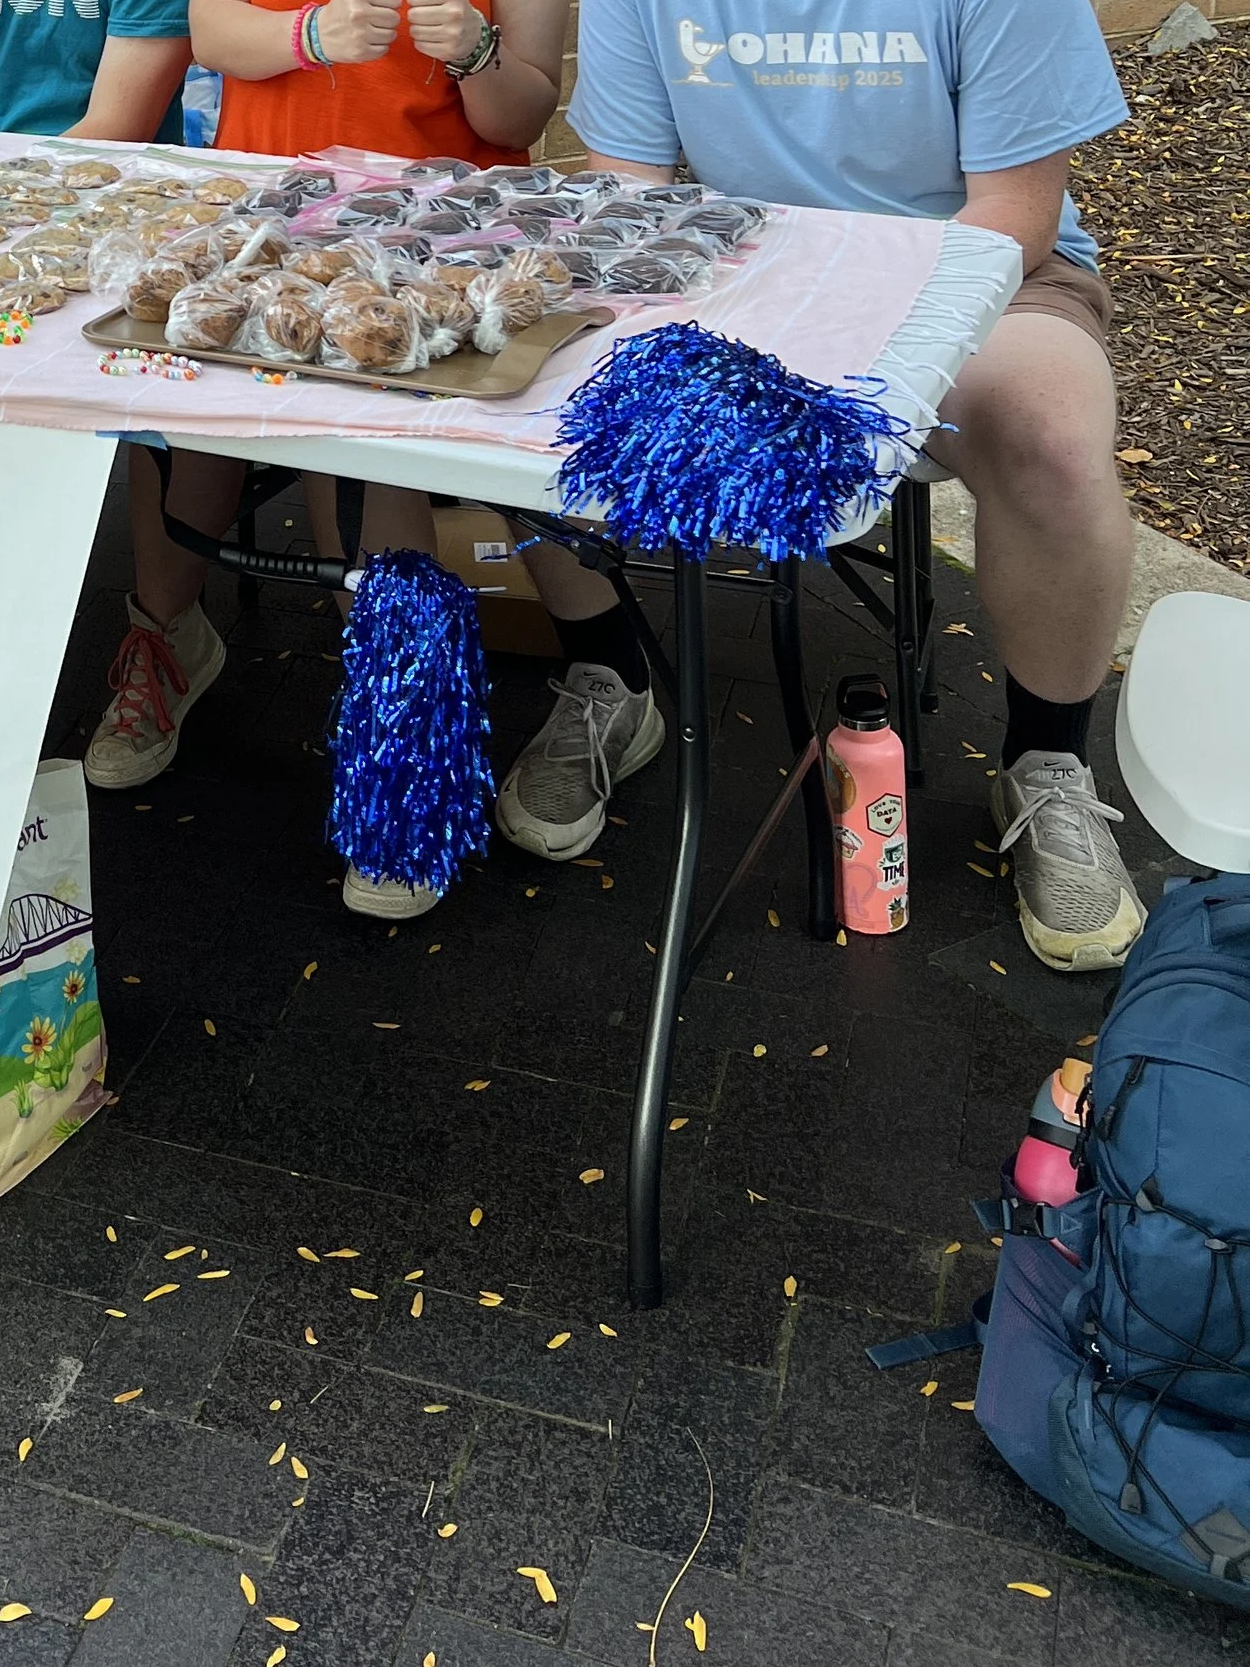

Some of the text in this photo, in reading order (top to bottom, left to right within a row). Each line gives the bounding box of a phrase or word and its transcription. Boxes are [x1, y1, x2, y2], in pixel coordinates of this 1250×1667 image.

[727, 31, 928, 65] OHANA
[752, 69, 904, 92] leaderip 2025
[876, 807, 897, 818] DATA
